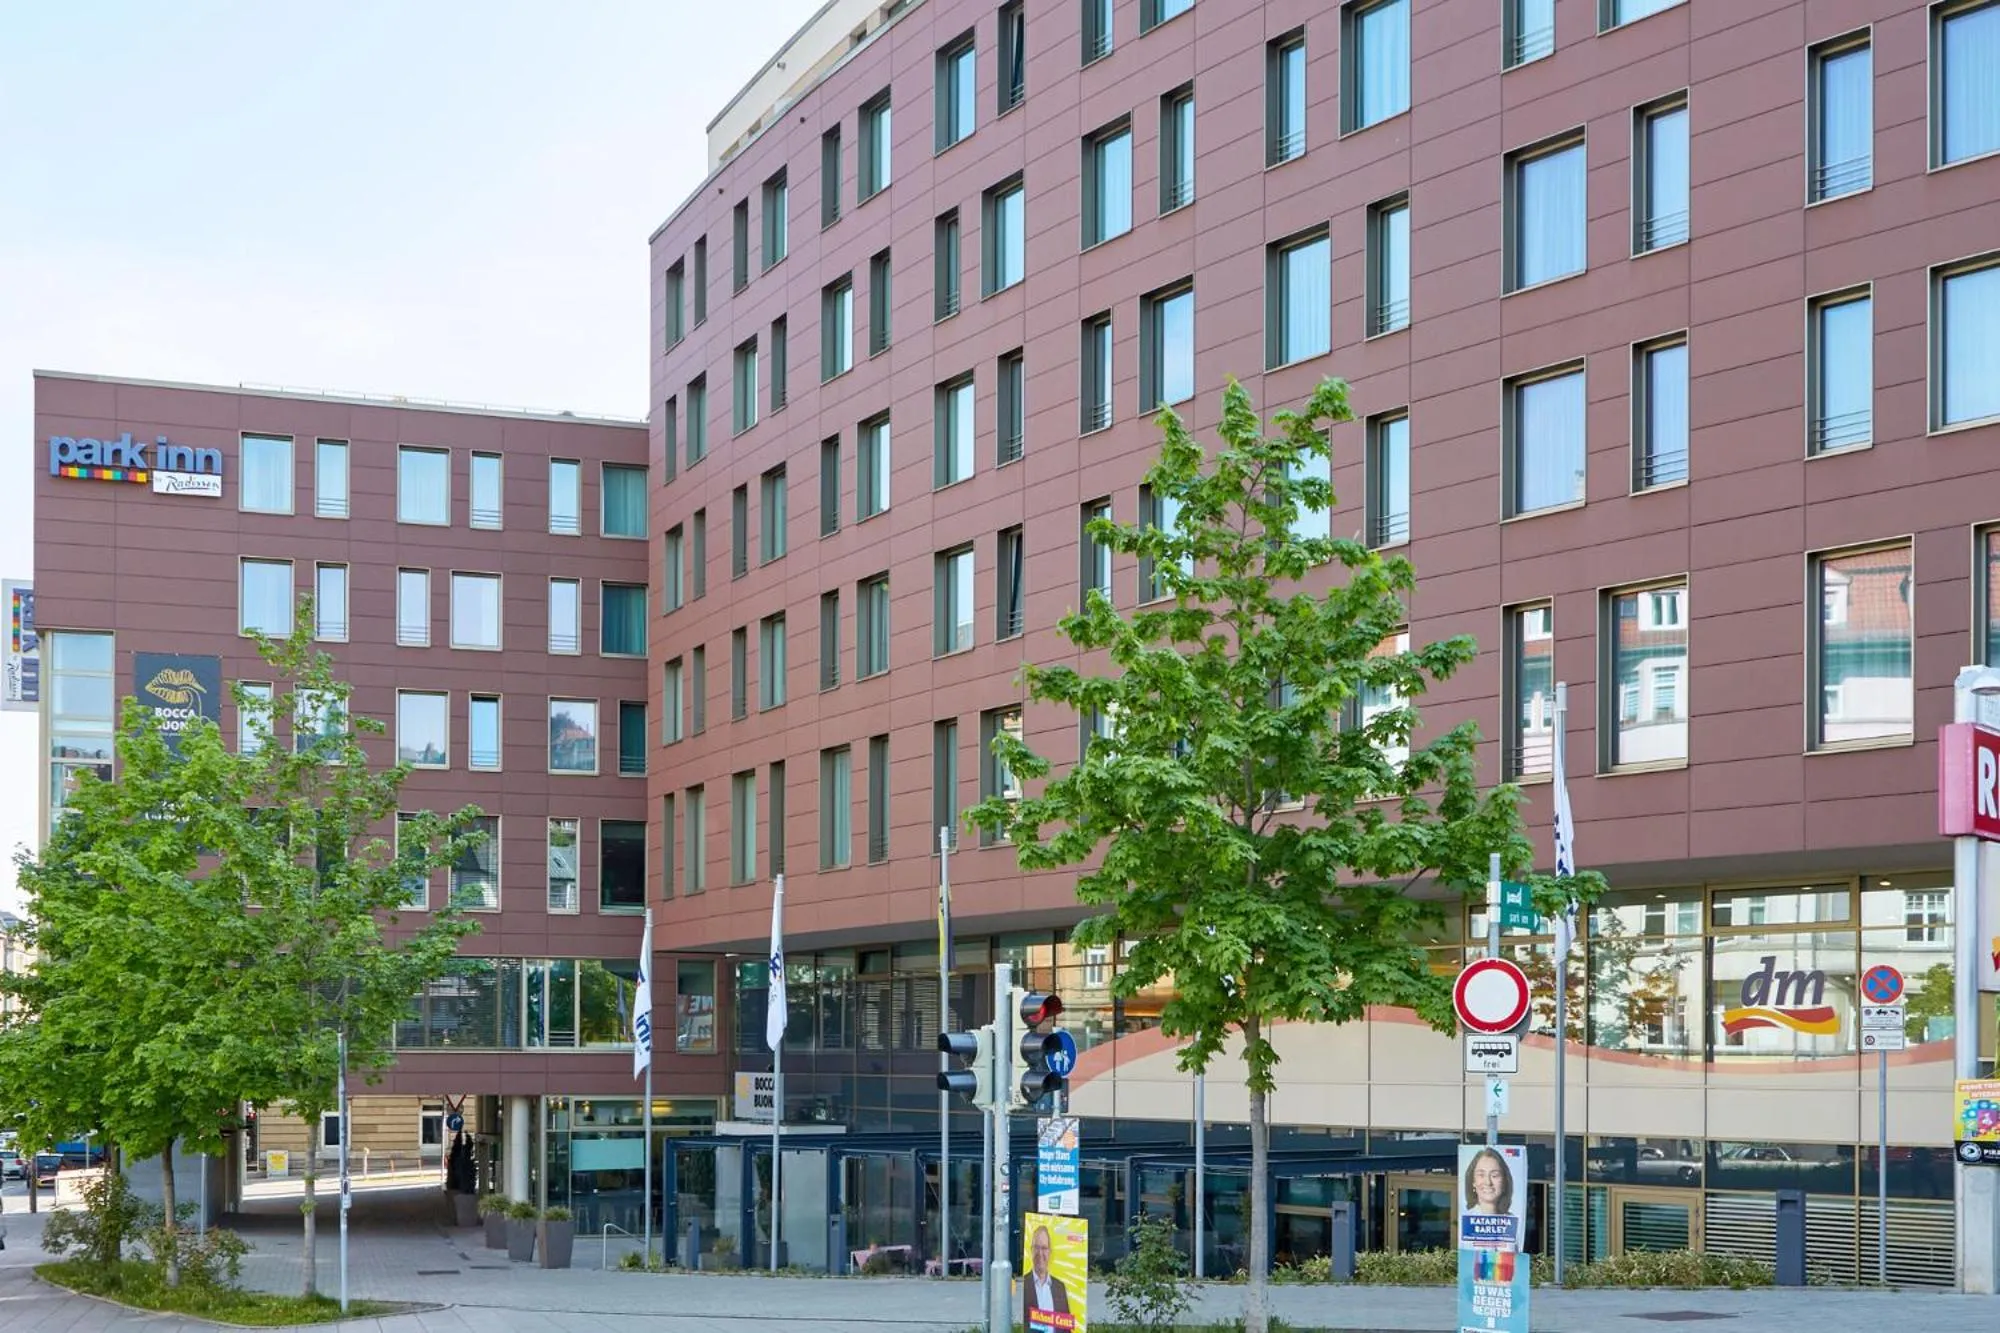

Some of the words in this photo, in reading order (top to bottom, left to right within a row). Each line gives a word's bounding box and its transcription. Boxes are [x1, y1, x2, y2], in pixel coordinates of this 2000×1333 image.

[49, 432, 148, 476] park
[157, 436, 222, 474] inn
[1741, 956, 1825, 1007] dm
[1483, 1060, 1501, 1069] frei
[755, 1077, 775, 1090] BOCC
[1470, 1217, 1511, 1226] KATARINA
[1474, 1225, 1507, 1234] BARLEY
[1487, 1287, 1512, 1298] WAS
